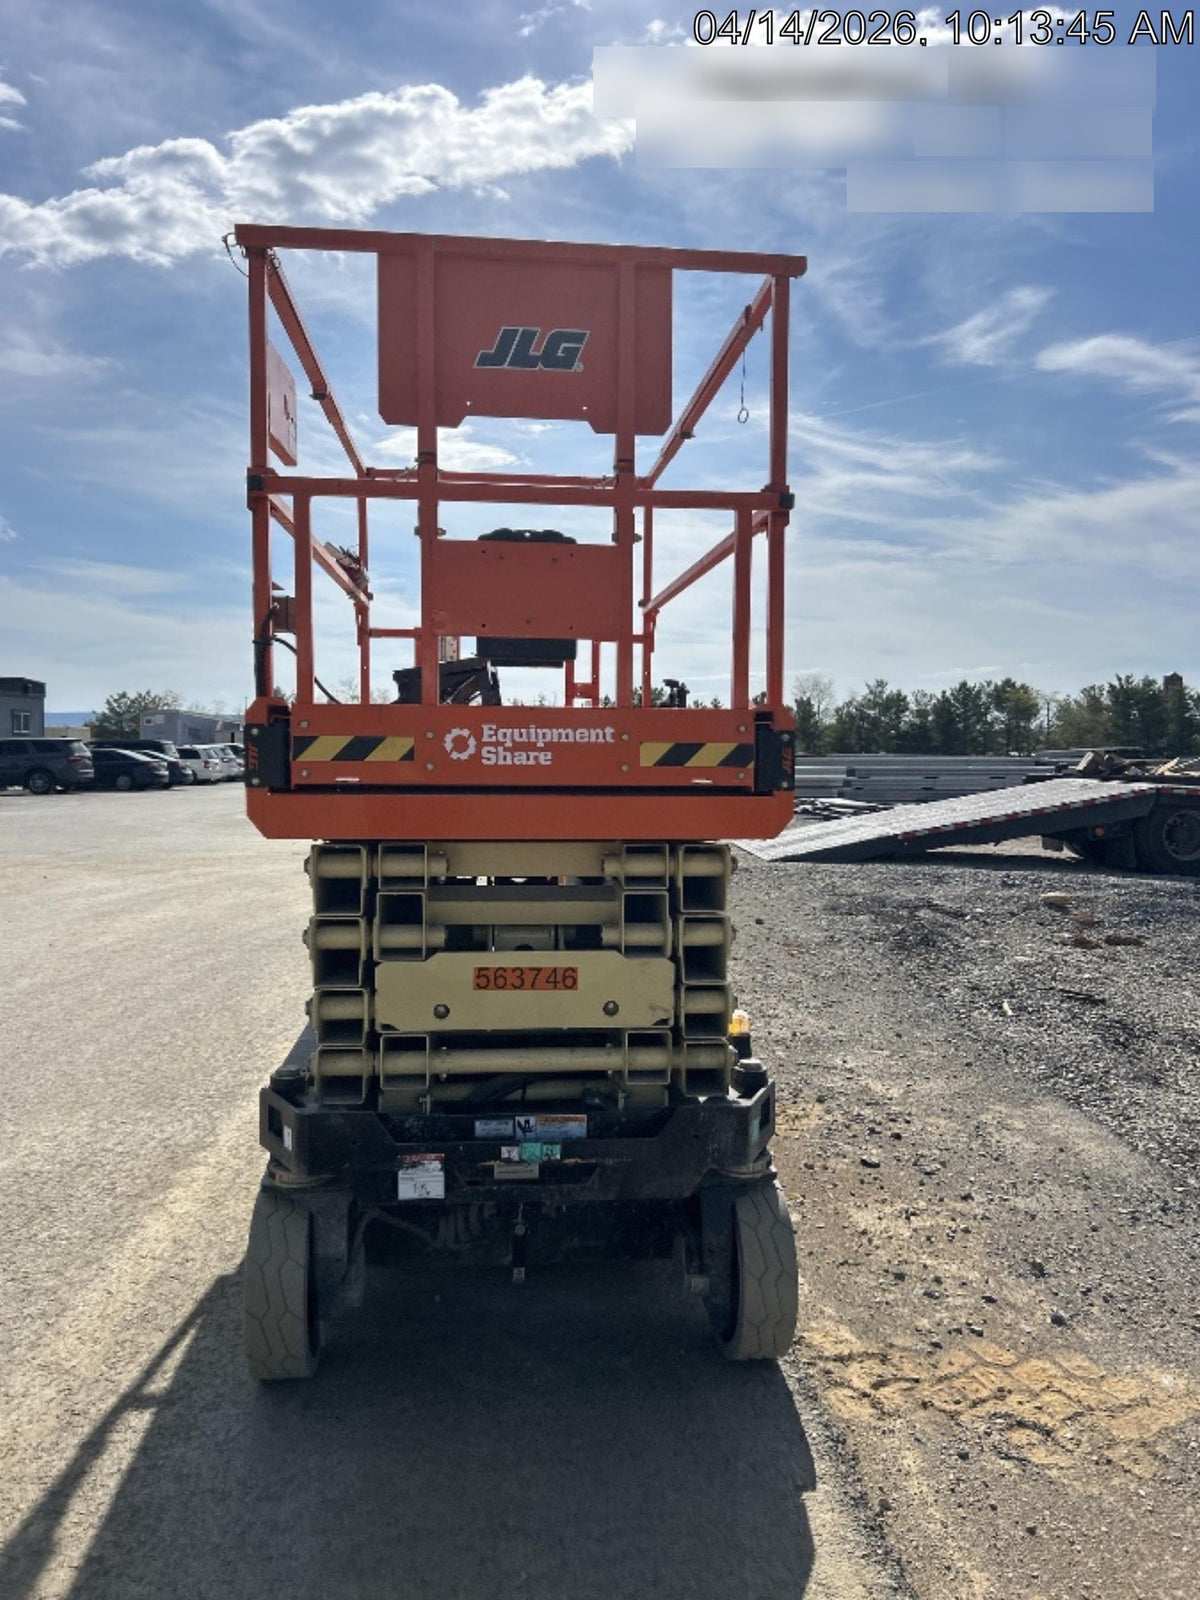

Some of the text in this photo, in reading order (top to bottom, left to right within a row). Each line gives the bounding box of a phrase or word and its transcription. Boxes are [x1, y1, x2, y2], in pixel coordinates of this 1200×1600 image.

[481, 724, 615, 747] Equipment
[481, 746, 553, 765] Share
[475, 966, 577, 989] 563746
